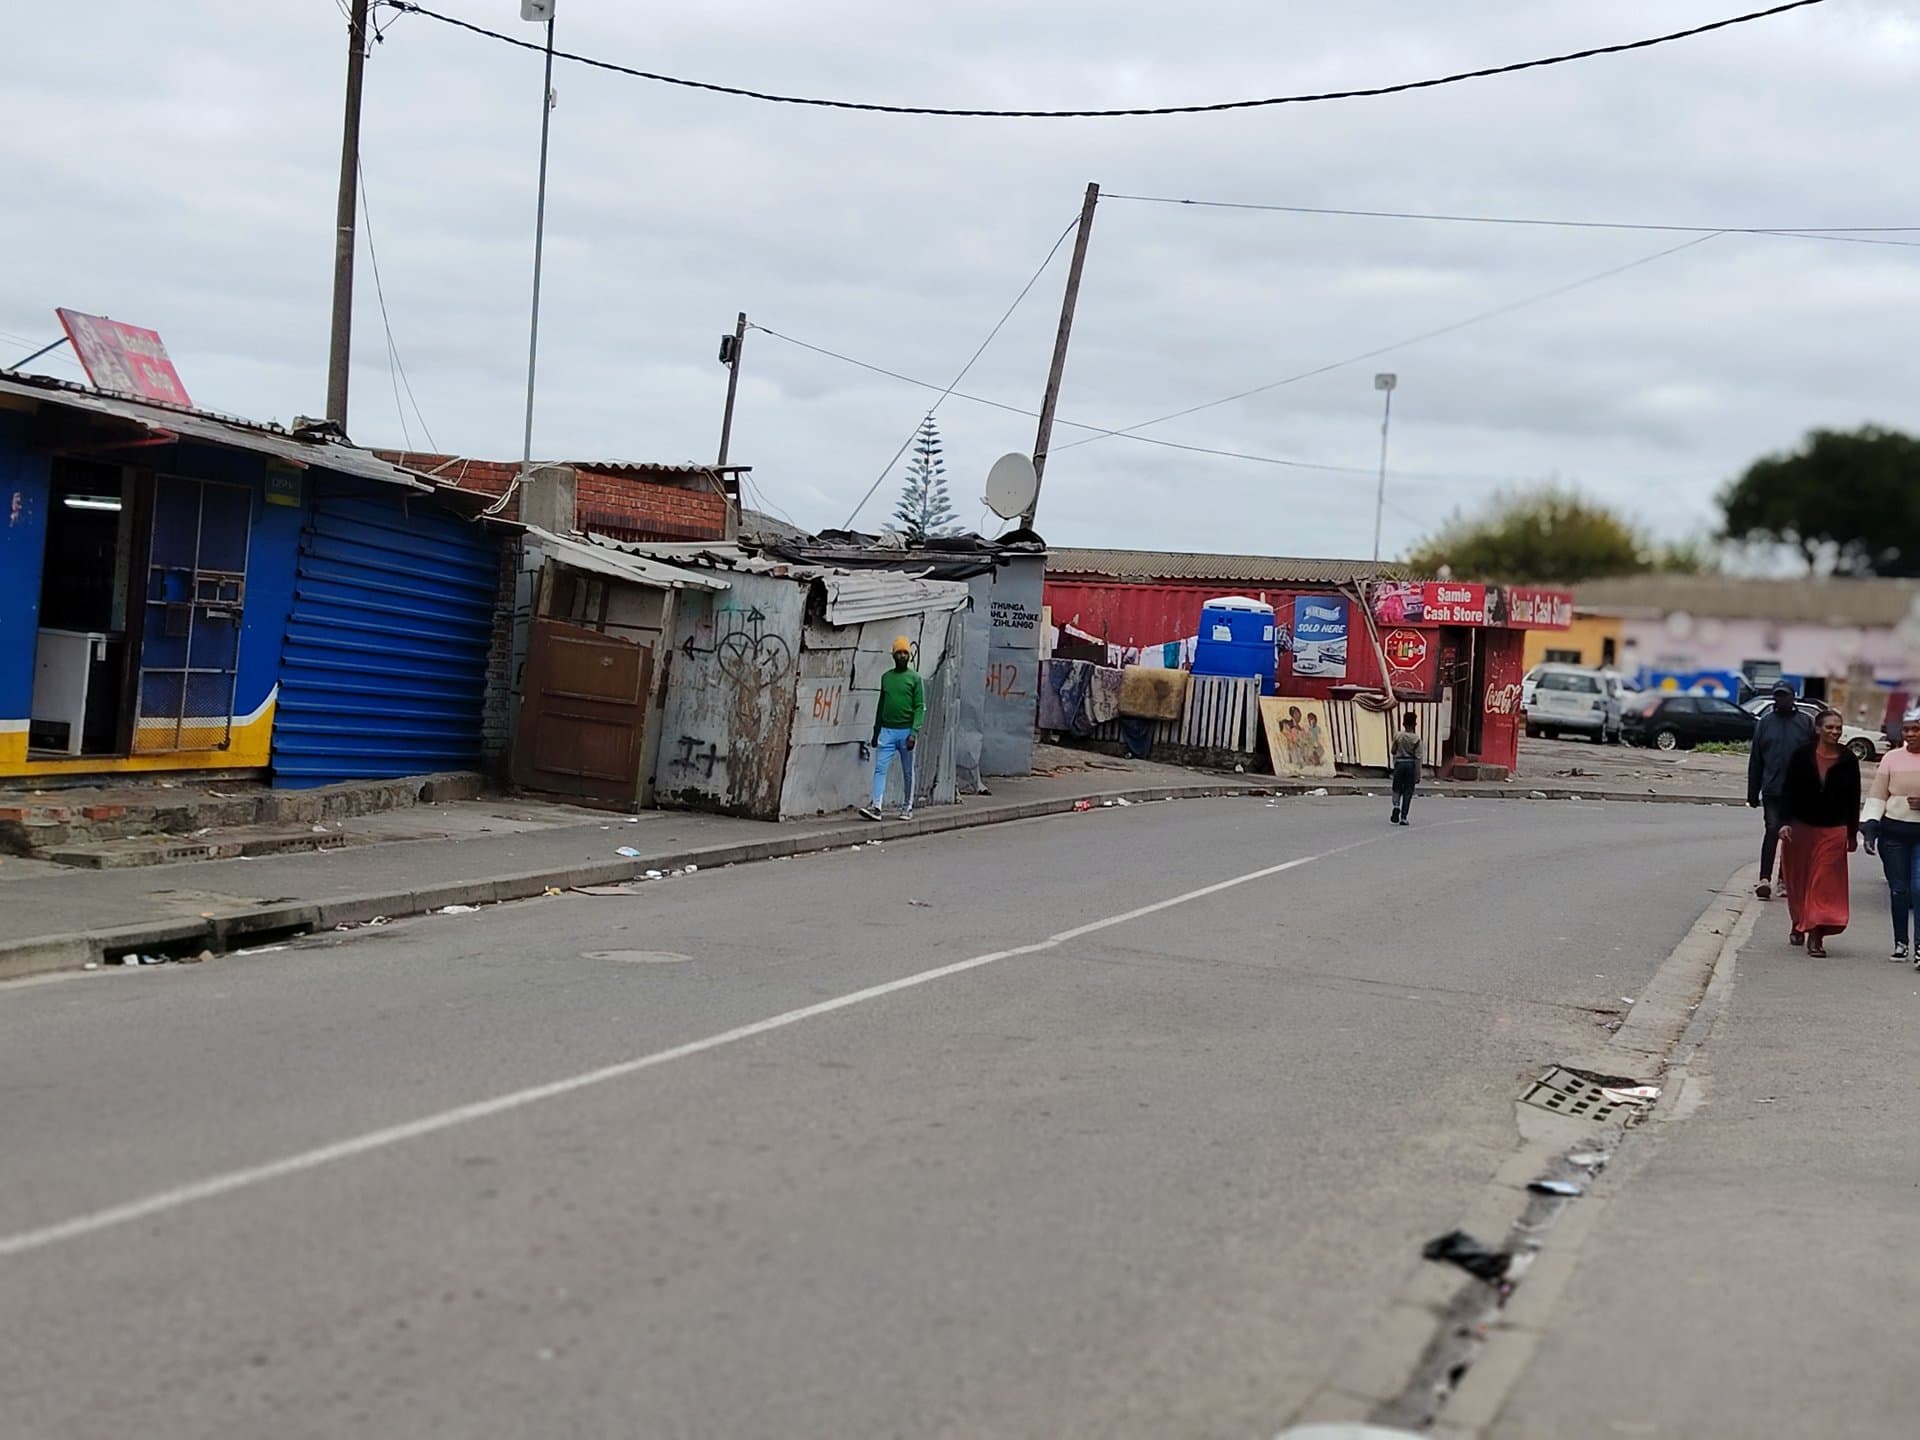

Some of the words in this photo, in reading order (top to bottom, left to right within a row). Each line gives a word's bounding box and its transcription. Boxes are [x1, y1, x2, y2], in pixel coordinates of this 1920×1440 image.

[1437, 587, 1471, 603] Samie
[1424, 606, 1450, 621] Cash
[1453, 606, 1483, 622] Store
[1297, 624, 1319, 633] SOLD
[1321, 624, 1346, 633] HERE
